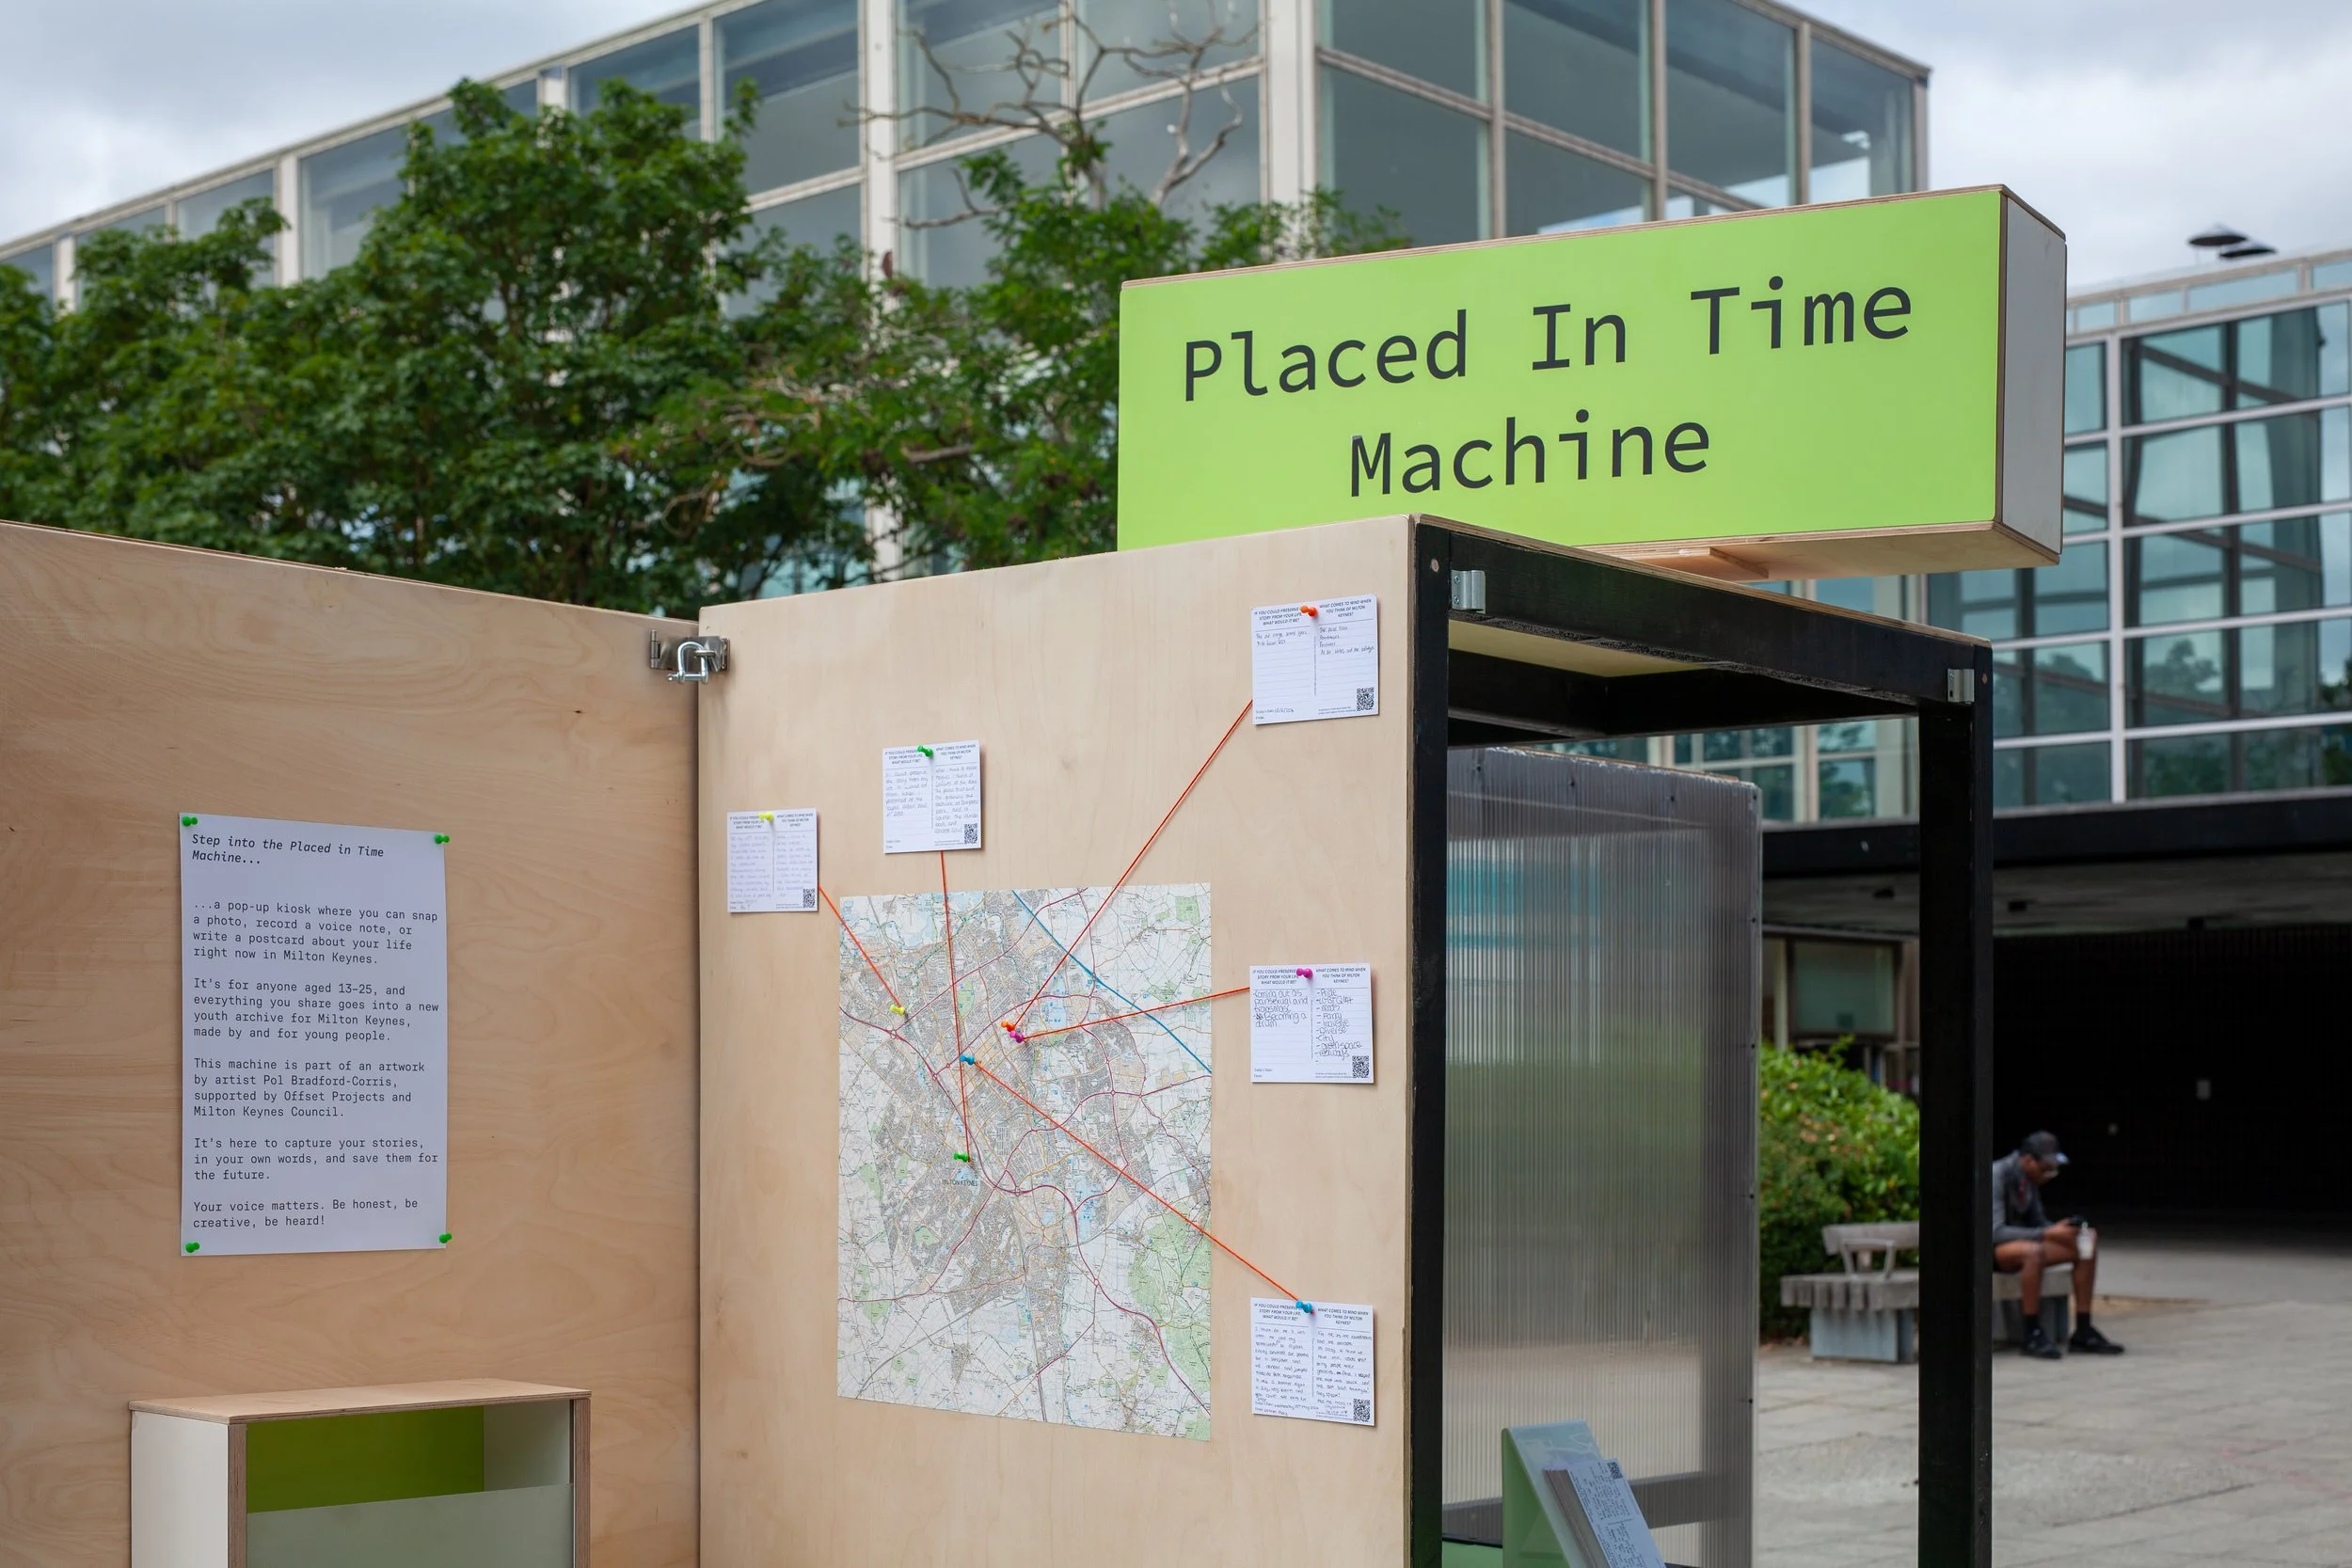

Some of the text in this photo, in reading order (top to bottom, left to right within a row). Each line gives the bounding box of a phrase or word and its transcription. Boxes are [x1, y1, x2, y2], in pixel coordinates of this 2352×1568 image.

[1186, 277, 1911, 401] Placed In Time
[1352, 409, 1708, 497] Machine
[191, 834, 384, 857] Step into the Placed in Time
[192, 850, 260, 864] Machine...
[228, 902, 270, 914] pop-up
[277, 903, 311, 915] kiosk
[317, 906, 352, 917] where
[359, 910, 379, 920] you
[385, 911, 405, 919] can
[412, 912, 438, 923] snap
[193, 915, 412, 936] a photo, record a voice note, or
[192, 931, 412, 950] write a postcard about your life
[193, 947, 377, 965] right now in Milton Keynes.
[228, 979, 249, 990] for
[256, 982, 297, 993] anyone
[304, 982, 331, 995] aged
[385, 985, 405, 996] and
[194, 995, 439, 1012] everything you share goes into a new
[193, 1010, 410, 1028] youth archive for Milton Keynes,
[193, 1026, 390, 1042] made by and for young people.
[193, 1057, 425, 1072] This machine is part of an artwork
[194, 1074, 397, 1088] by artist Pol Bradford-Corris,
[194, 1090, 411, 1104] supported by Offset Projects and
[193, 1105, 343, 1119] Milton Keynes Council.
[229, 1137, 257, 1148] here
[264, 1139, 278, 1148] to
[284, 1138, 332, 1150] capture
[338, 1139, 366, 1150] your
[372, 1137, 423, 1149] stories,
[194, 1152, 439, 1167] in your own words, and save them for
[194, 1169, 270, 1180] the future.
[192, 1198, 418, 1212] Your voice matters. Be honest, be
[193, 1215, 324, 1228] creative, be heard!
